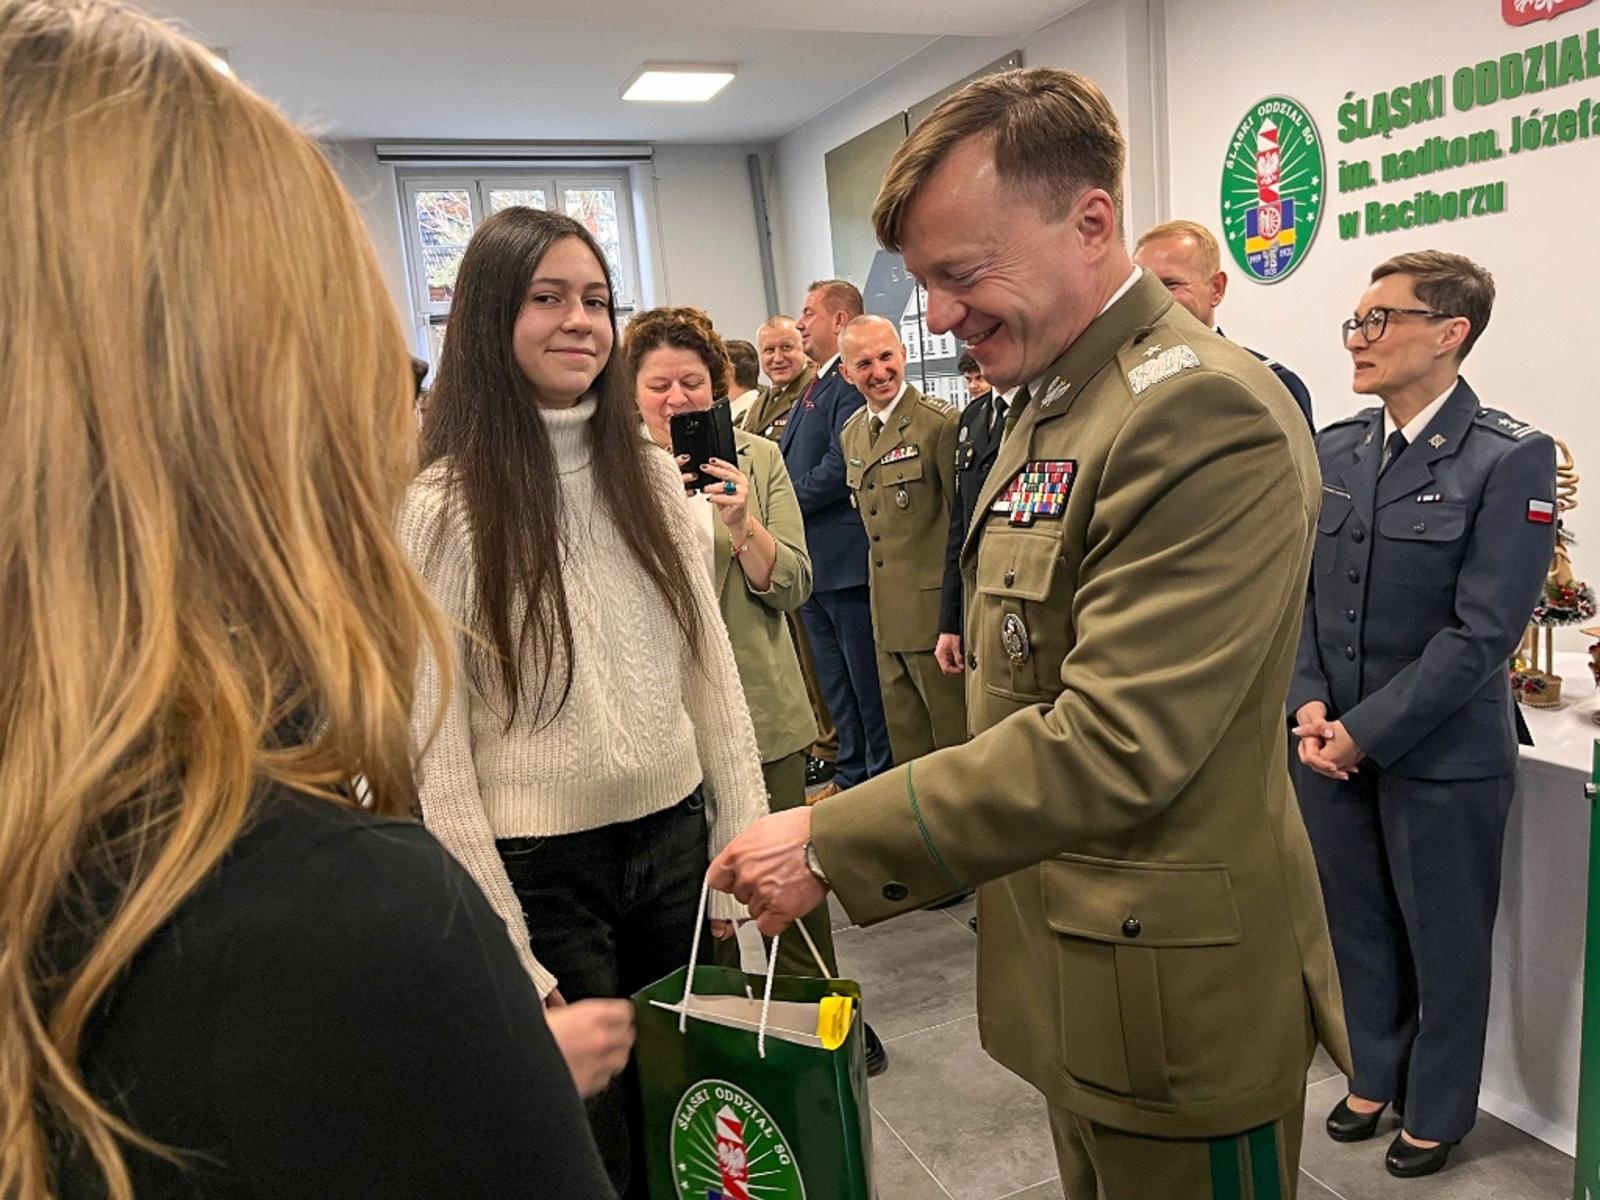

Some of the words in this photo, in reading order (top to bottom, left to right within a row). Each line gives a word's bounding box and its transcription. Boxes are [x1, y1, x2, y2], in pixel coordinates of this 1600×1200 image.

[1337, 74, 1445, 143] ŚLĄSKI
[1338, 160, 1377, 194] im.
[1382, 129, 1503, 183] nadkom.
[1338, 211, 1359, 240] w
[1365, 181, 1505, 235] Raciborzu
[774, 1143, 790, 1165] SG
